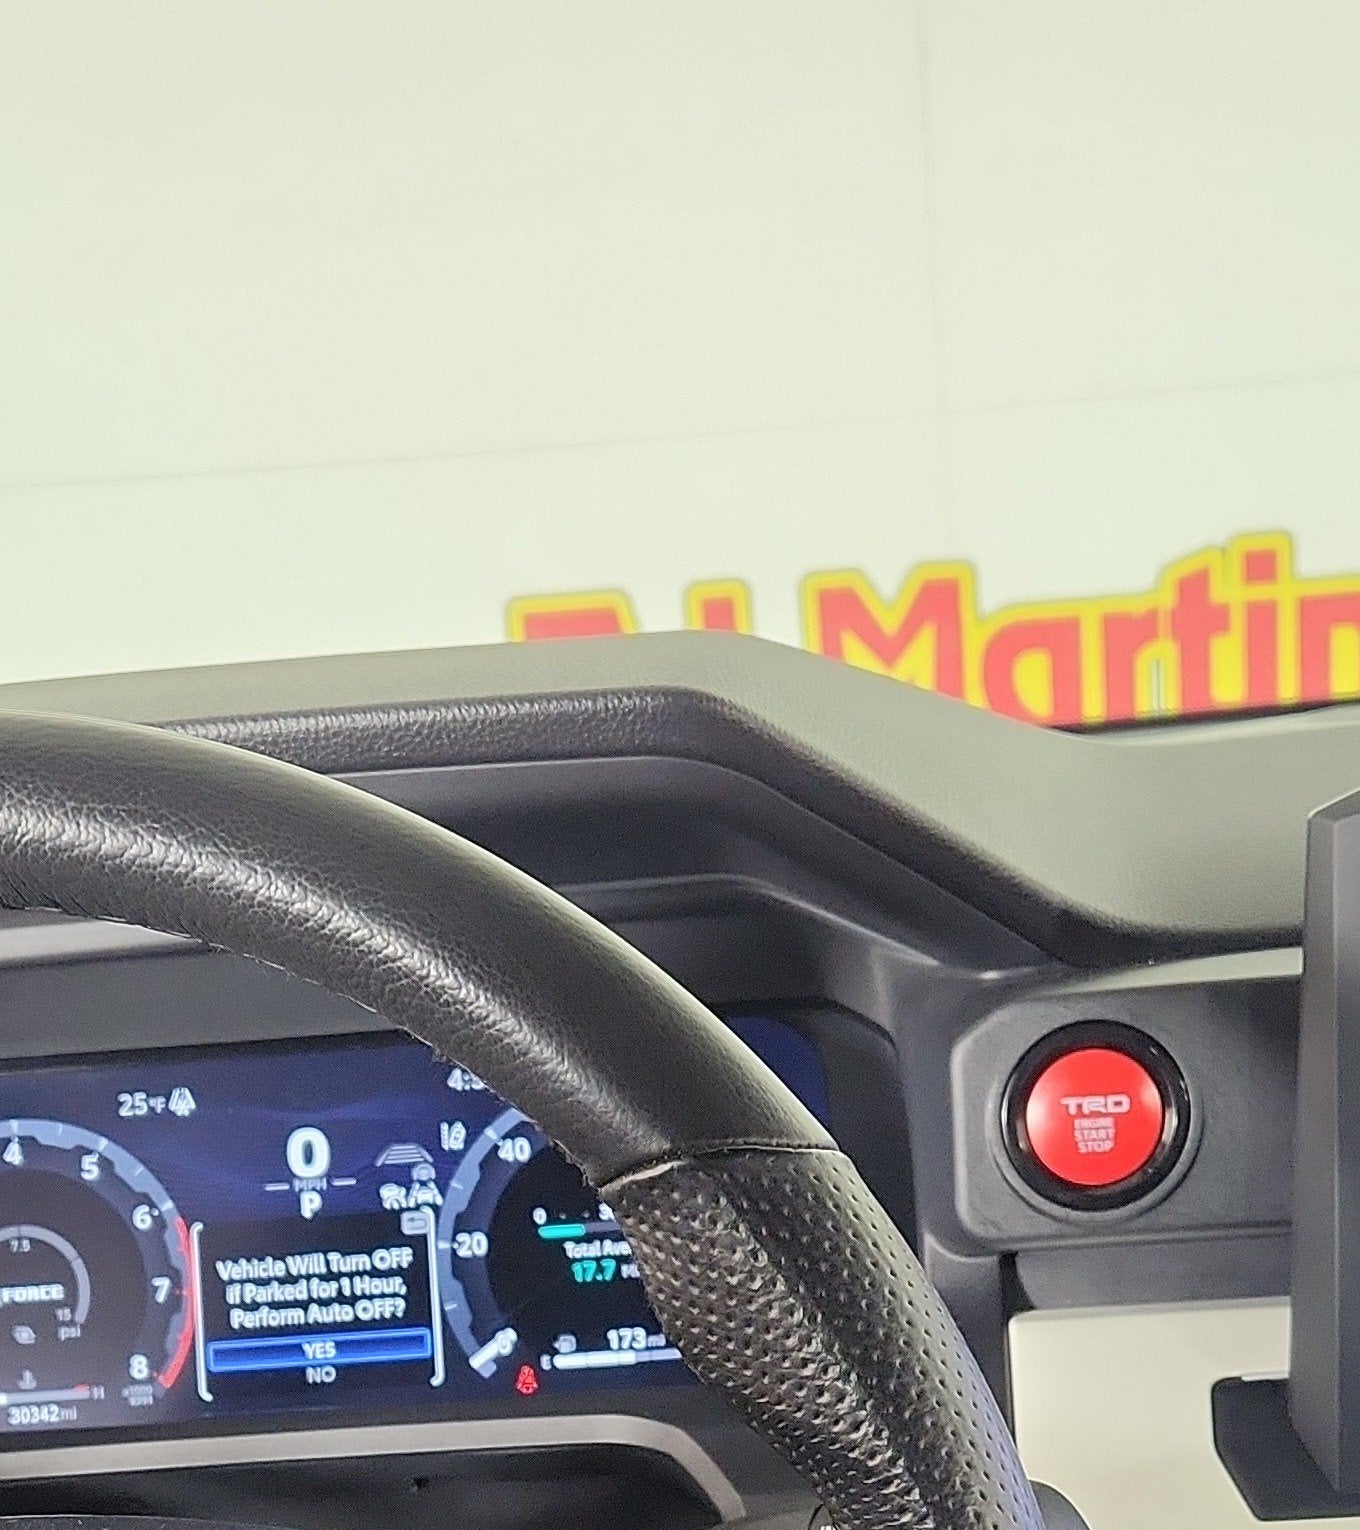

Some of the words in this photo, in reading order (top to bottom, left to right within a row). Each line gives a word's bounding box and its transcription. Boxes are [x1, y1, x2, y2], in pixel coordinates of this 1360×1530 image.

[1059, 1093, 1131, 1116] TRD
[1073, 1129, 1115, 1141] START
[1077, 1141, 1115, 1154] STOP
[3, 1141, 23, 1165] 4
[286, 1126, 331, 1178] 0
[498, 1136, 532, 1163] 40
[80, 1154, 99, 1181] 5
[131, 1204, 152, 1230] 6
[299, 1190, 323, 1219] P
[456, 1231, 488, 1258] 20
[563, 1239, 601, 1259] Total
[215, 1256, 286, 1281] Vehicle
[286, 1252, 327, 1277] Will
[327, 1251, 371, 1274] Turn
[371, 1247, 413, 1269] OFF
[572, 1259, 617, 1282] 17.7
[150, 1277, 171, 1303] 7
[242, 1279, 308, 1304] Parked
[309, 1276, 338, 1299] for
[340, 1276, 352, 1296] 1
[230, 1305, 305, 1329] Perform
[307, 1302, 354, 1324] Auto
[354, 1297, 406, 1321] OFF?
[302, 1341, 337, 1360] YES
[606, 1326, 647, 1350] 173
[128, 1354, 150, 1380] 8
[305, 1366, 337, 1384] NO
[7, 1403, 60, 1425] 30342
